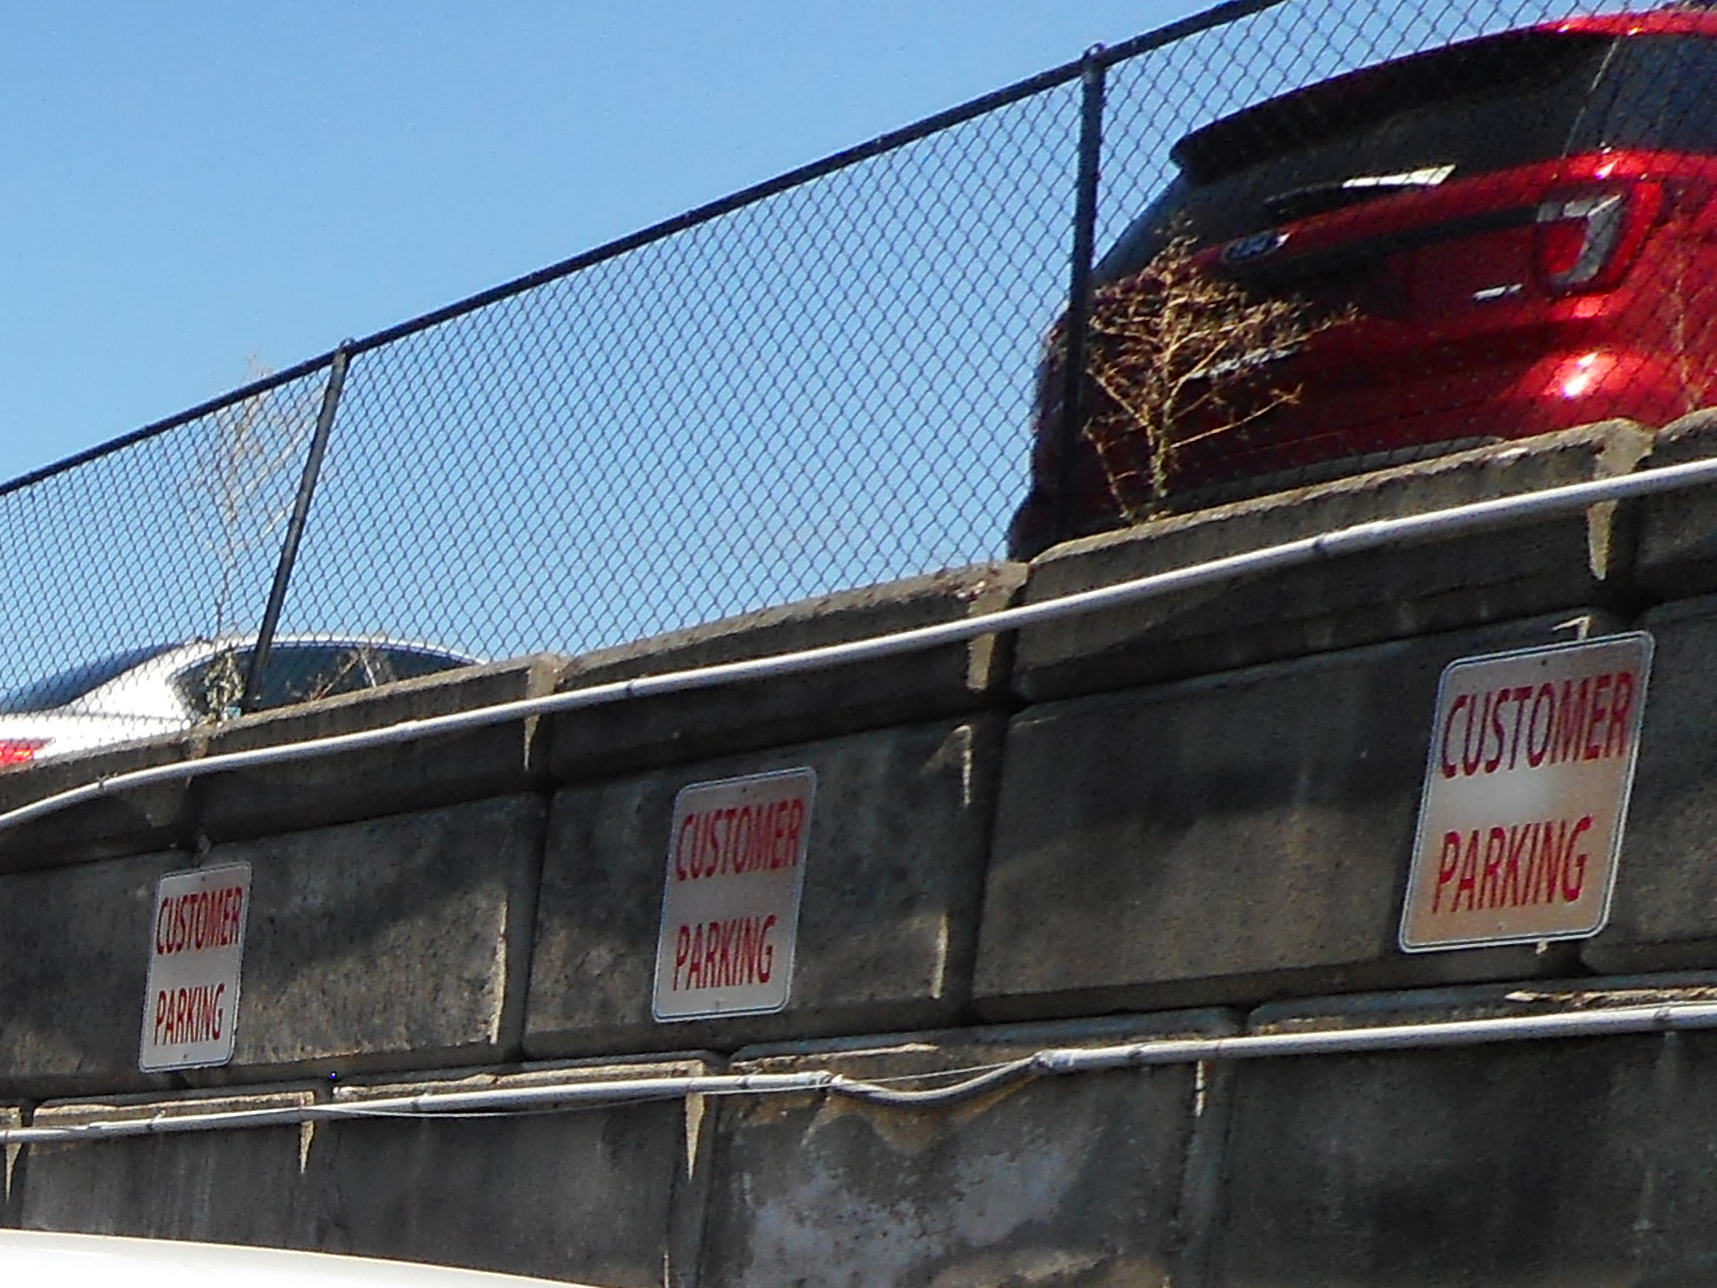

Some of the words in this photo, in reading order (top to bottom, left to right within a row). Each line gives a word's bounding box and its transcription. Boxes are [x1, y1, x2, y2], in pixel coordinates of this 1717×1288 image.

[1440, 670, 1637, 779] CUSTOMER
[675, 798, 806, 881] CUSTOMER
[1432, 814, 1594, 915] PARKING
[156, 886, 243, 956] CUSTOMER
[672, 914, 777, 992] PARKING
[153, 982, 225, 1046] PARKING
